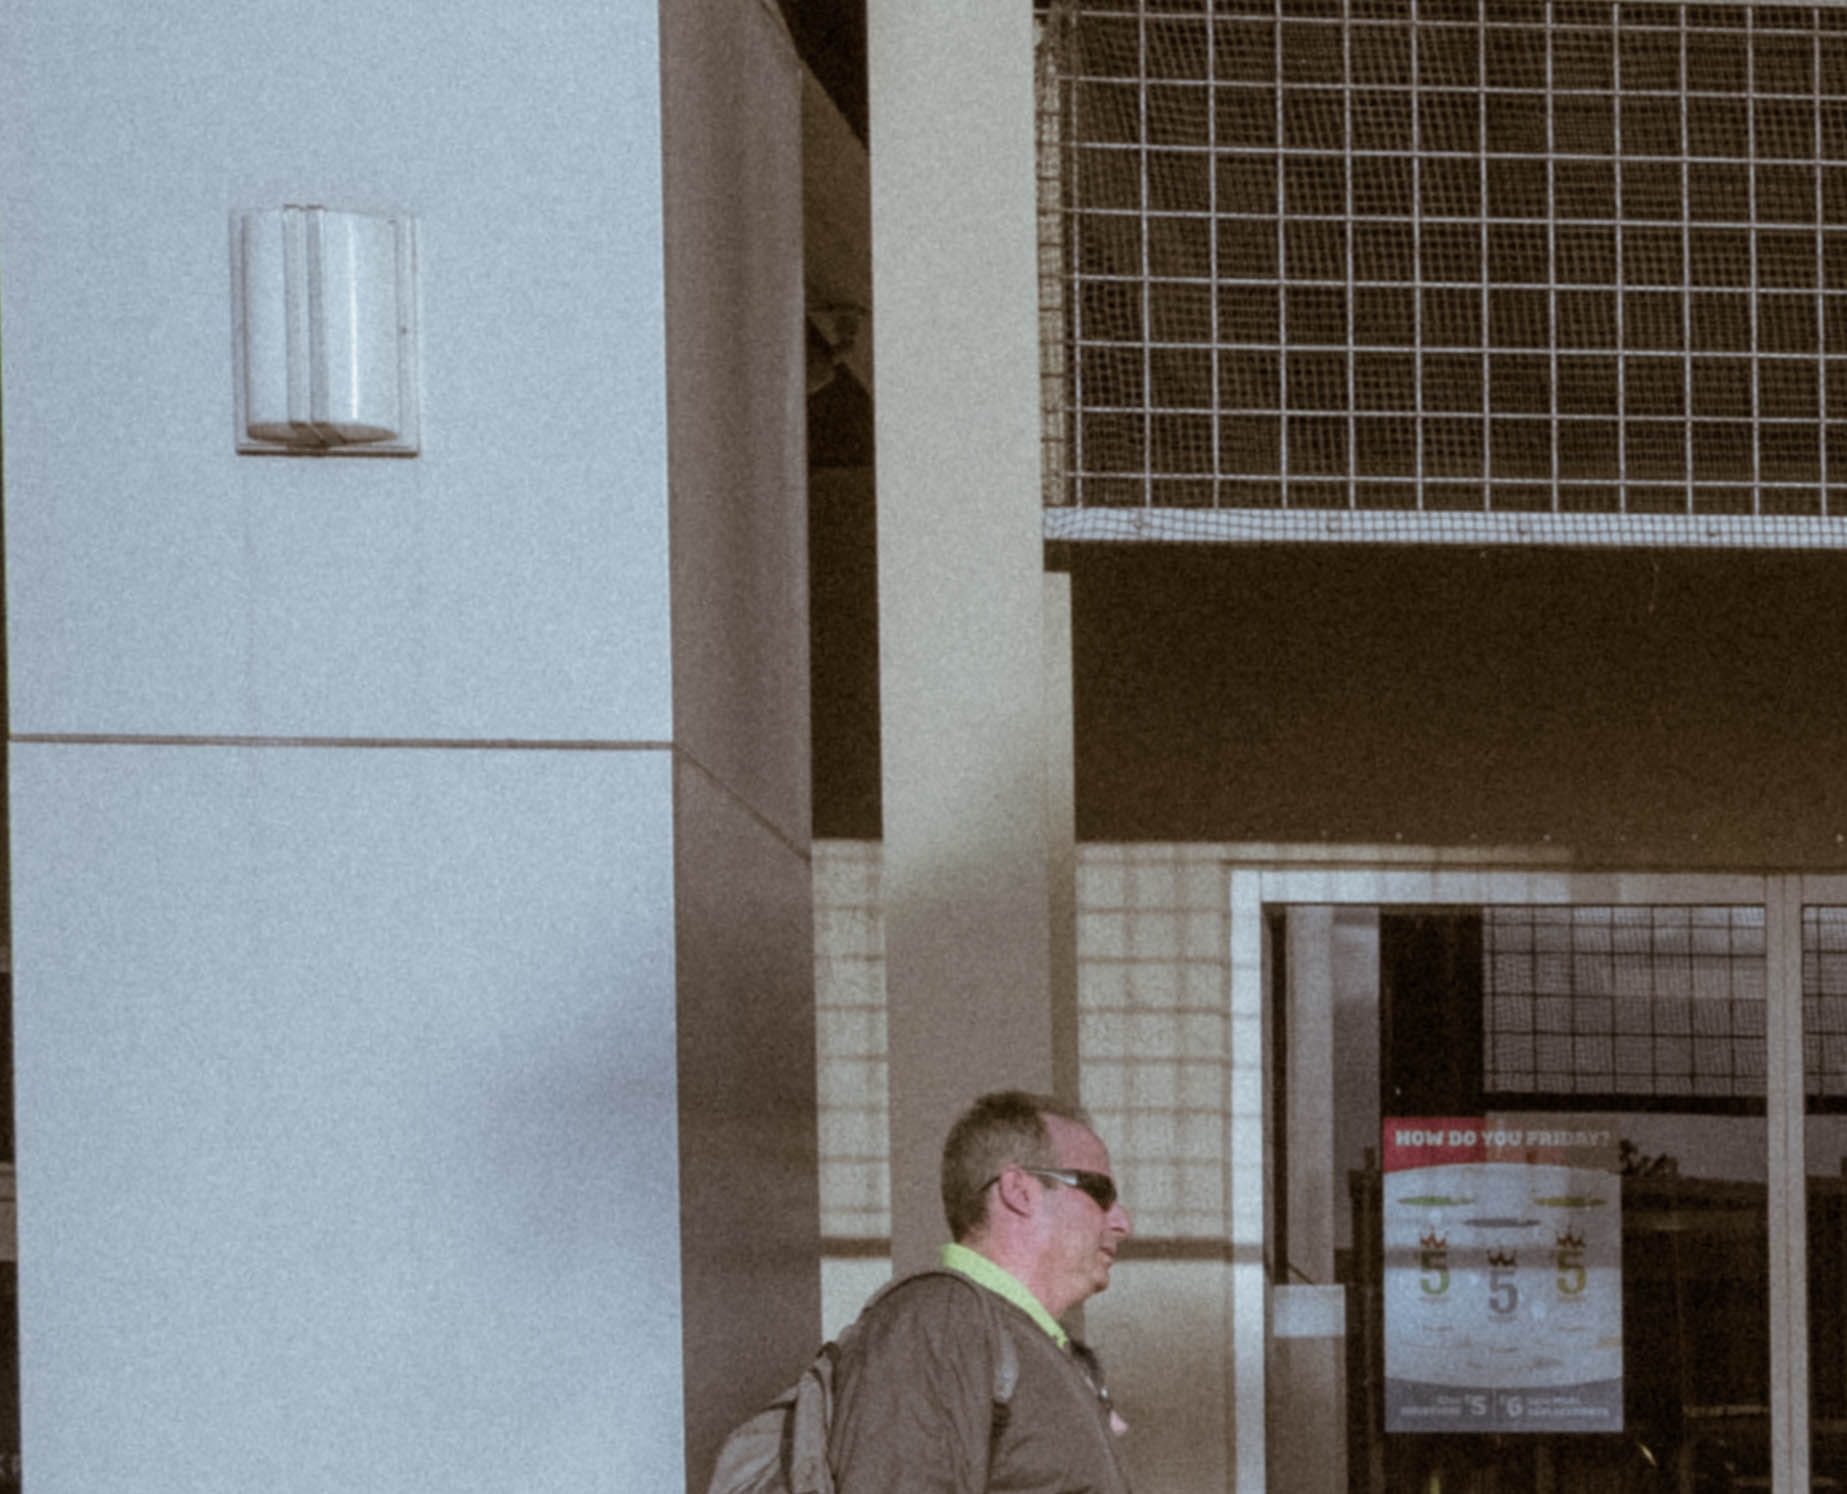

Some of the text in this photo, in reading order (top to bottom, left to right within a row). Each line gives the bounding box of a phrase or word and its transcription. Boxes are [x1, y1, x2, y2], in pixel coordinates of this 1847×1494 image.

[1395, 1130, 1445, 1147] HOW
[1448, 1130, 1477, 1147] DO
[1482, 1130, 1523, 1147] YOU
